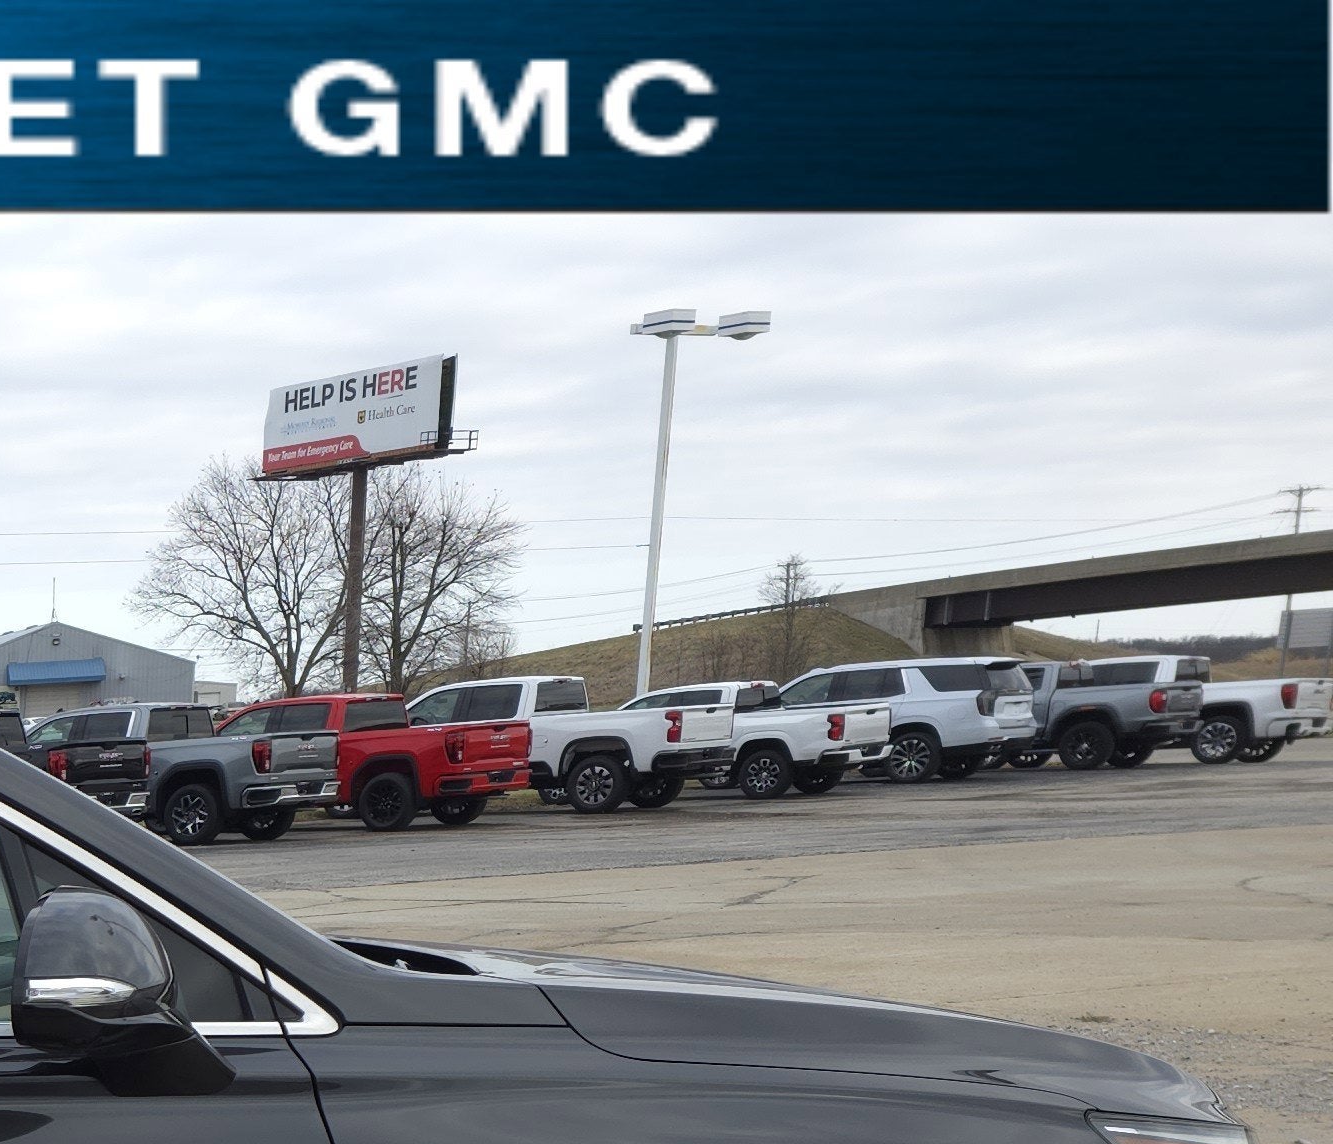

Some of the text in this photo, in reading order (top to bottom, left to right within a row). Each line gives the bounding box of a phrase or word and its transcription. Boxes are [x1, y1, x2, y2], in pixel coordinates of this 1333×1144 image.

[284, 365, 418, 413] HELP IS HERE
[368, 405, 415, 421] Health Care
[267, 440, 353, 463] Your Team for Emergency Care
